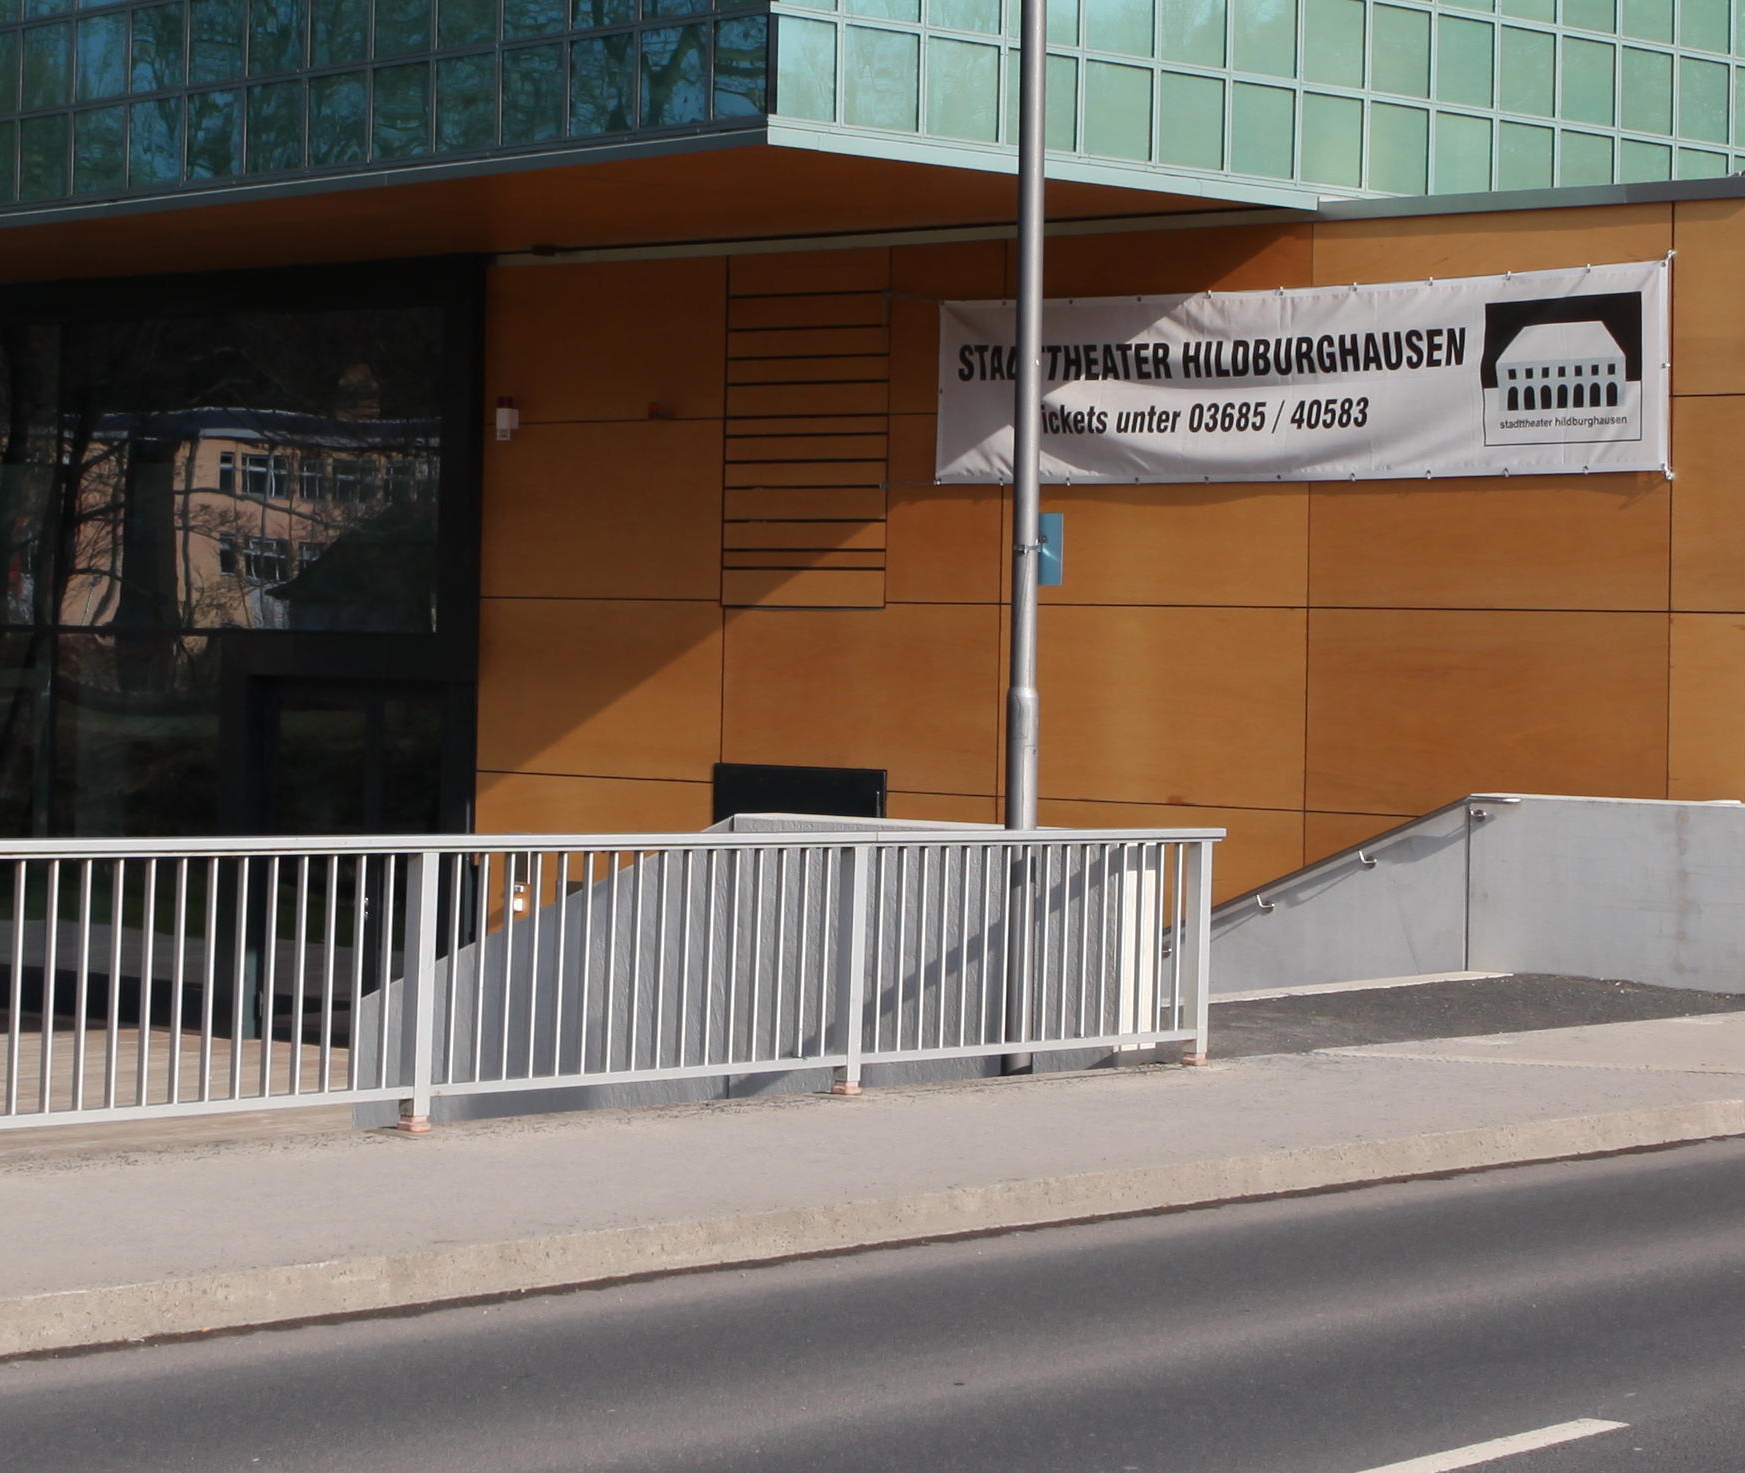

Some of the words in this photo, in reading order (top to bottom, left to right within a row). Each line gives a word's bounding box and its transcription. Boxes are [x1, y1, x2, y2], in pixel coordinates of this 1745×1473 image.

[1182, 327, 1466, 378] HILDBURGHAUSEN
[1041, 404, 1108, 434] ickets
[1116, 405, 1181, 434] unter
[1189, 401, 1267, 433] 03685
[1271, 400, 1285, 434] /
[1290, 397, 1369, 430] 40583
[1499, 418, 1553, 429] stadttheater
[1555, 416, 1628, 428] hildburghausen
